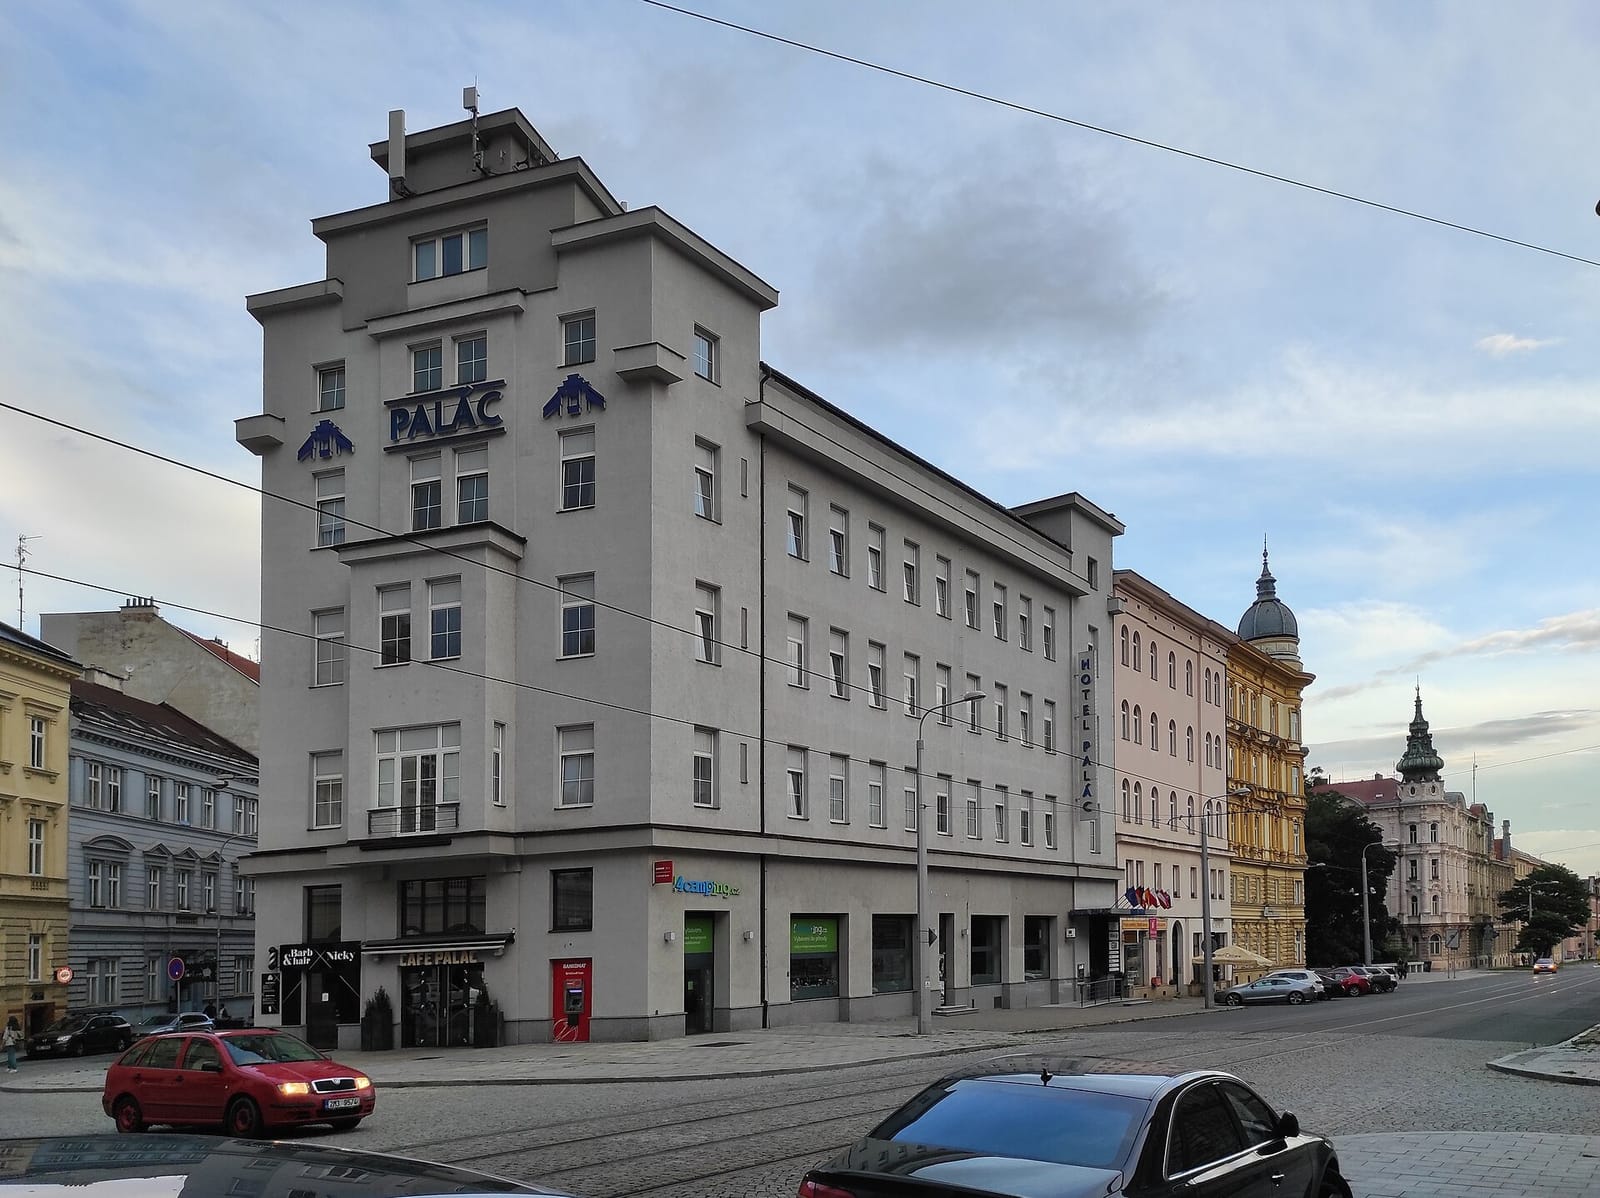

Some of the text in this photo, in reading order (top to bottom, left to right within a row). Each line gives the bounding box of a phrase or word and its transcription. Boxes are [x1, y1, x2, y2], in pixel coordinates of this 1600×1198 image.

[390, 384, 504, 440] PALÁC
[1080, 659, 1093, 813] HOTEL PALÁC
[290, 948, 313, 957] Barb
[326, 950, 355, 962] Nicky
[293, 957, 311, 966] hair
